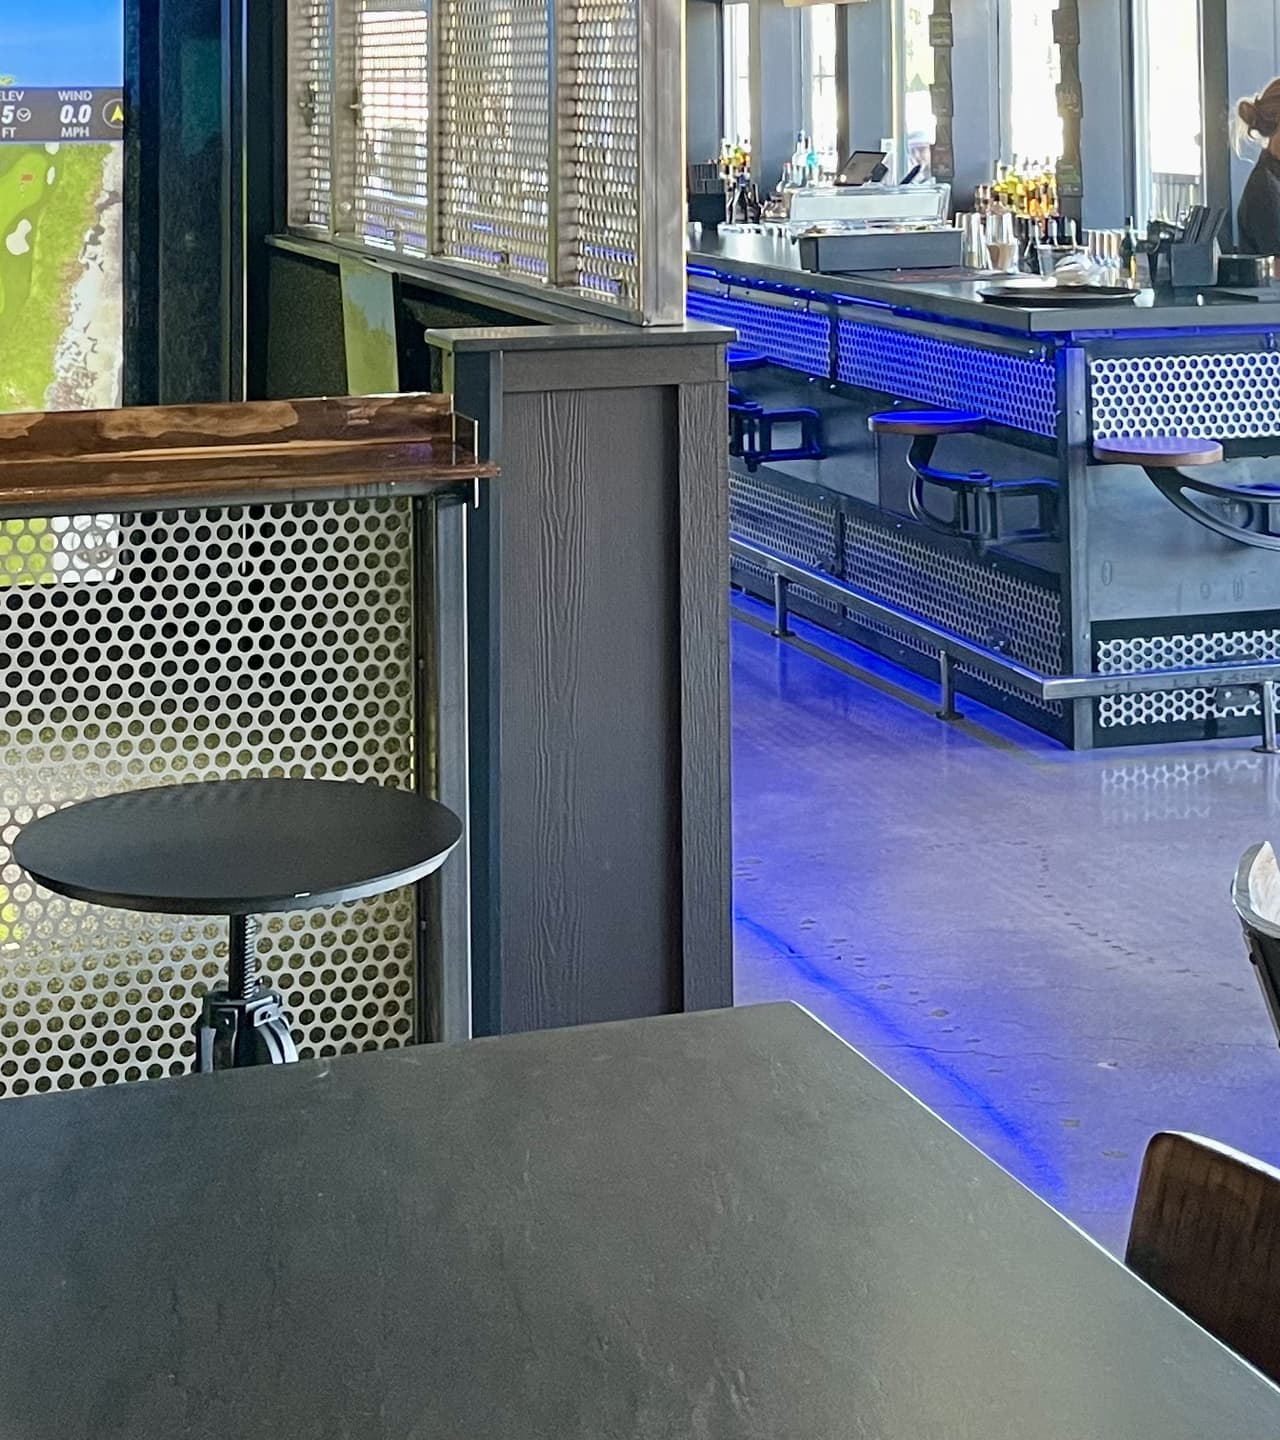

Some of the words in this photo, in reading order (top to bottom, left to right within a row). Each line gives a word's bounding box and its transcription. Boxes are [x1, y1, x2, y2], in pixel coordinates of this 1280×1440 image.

[58, 90, 92, 102] WIND
[1, 106, 14, 125] 5
[59, 105, 92, 124] 0.0
[2, 127, 17, 138] FT
[61, 127, 90, 138] MPH
